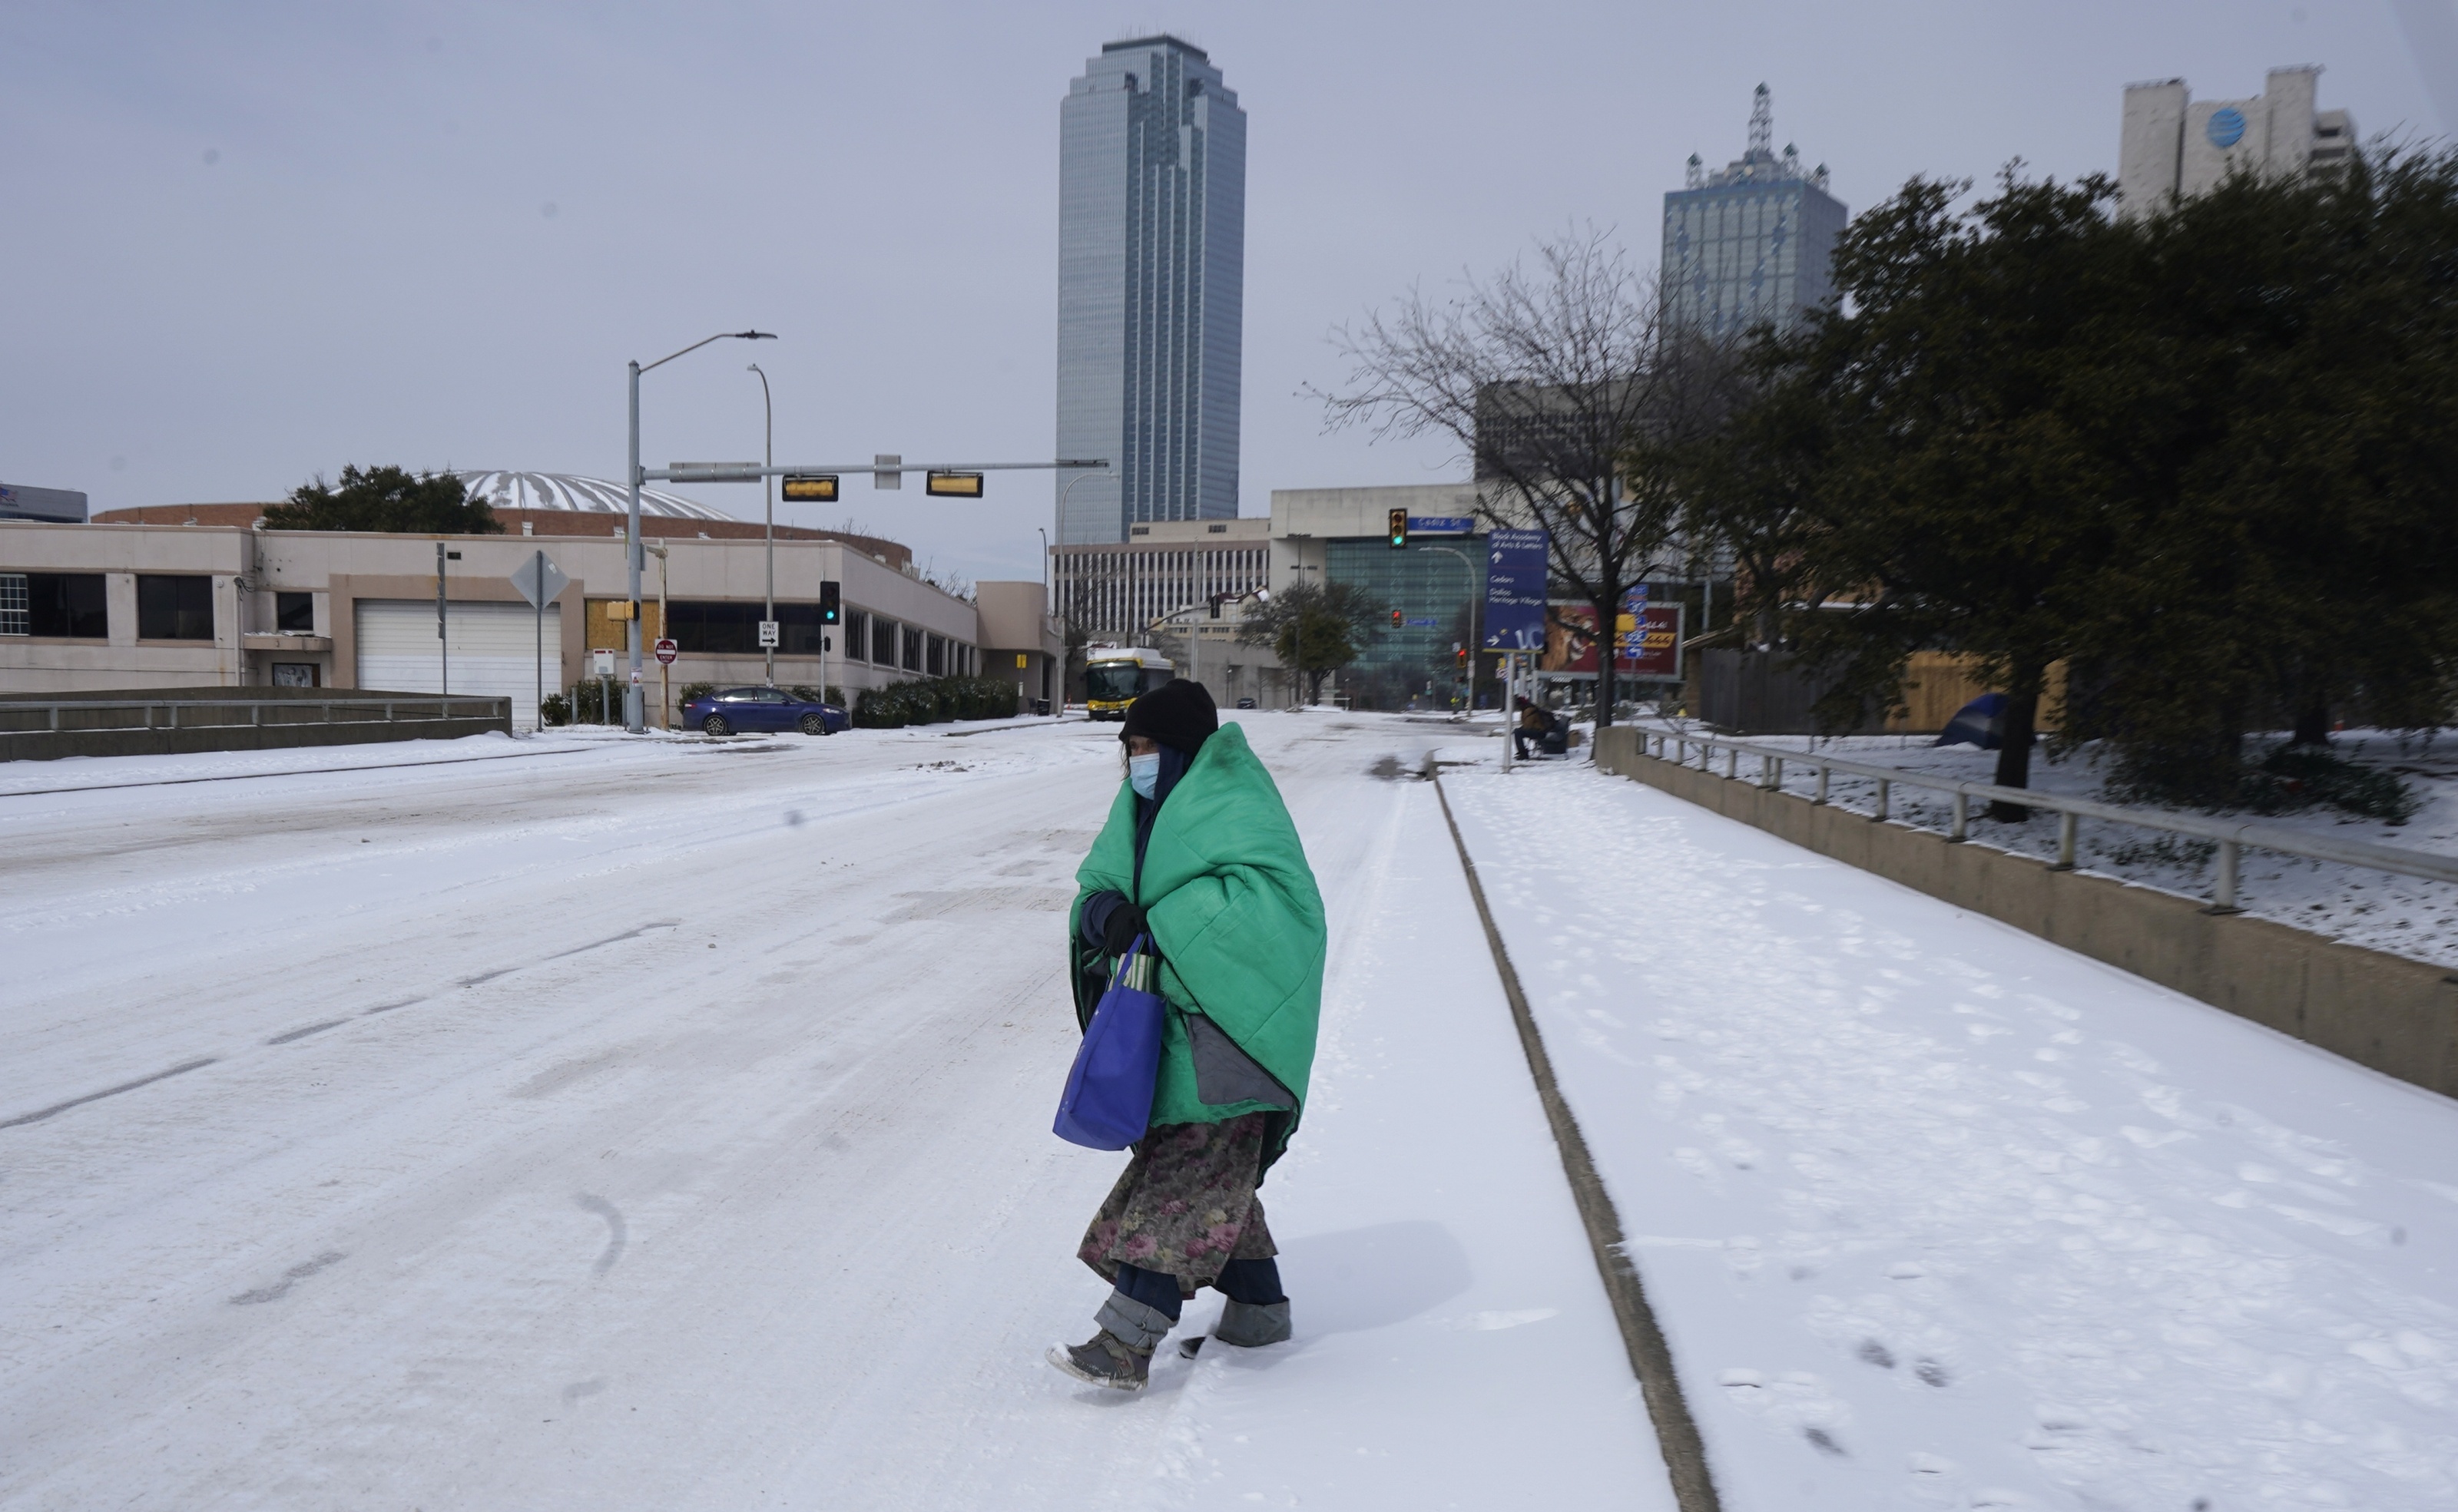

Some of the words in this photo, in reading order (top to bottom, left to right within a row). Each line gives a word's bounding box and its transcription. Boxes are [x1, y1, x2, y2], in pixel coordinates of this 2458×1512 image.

[1418, 518, 1446, 527] Cadiz
[1489, 574, 1515, 584] Cedars
[1519, 596, 1543, 607] Village
